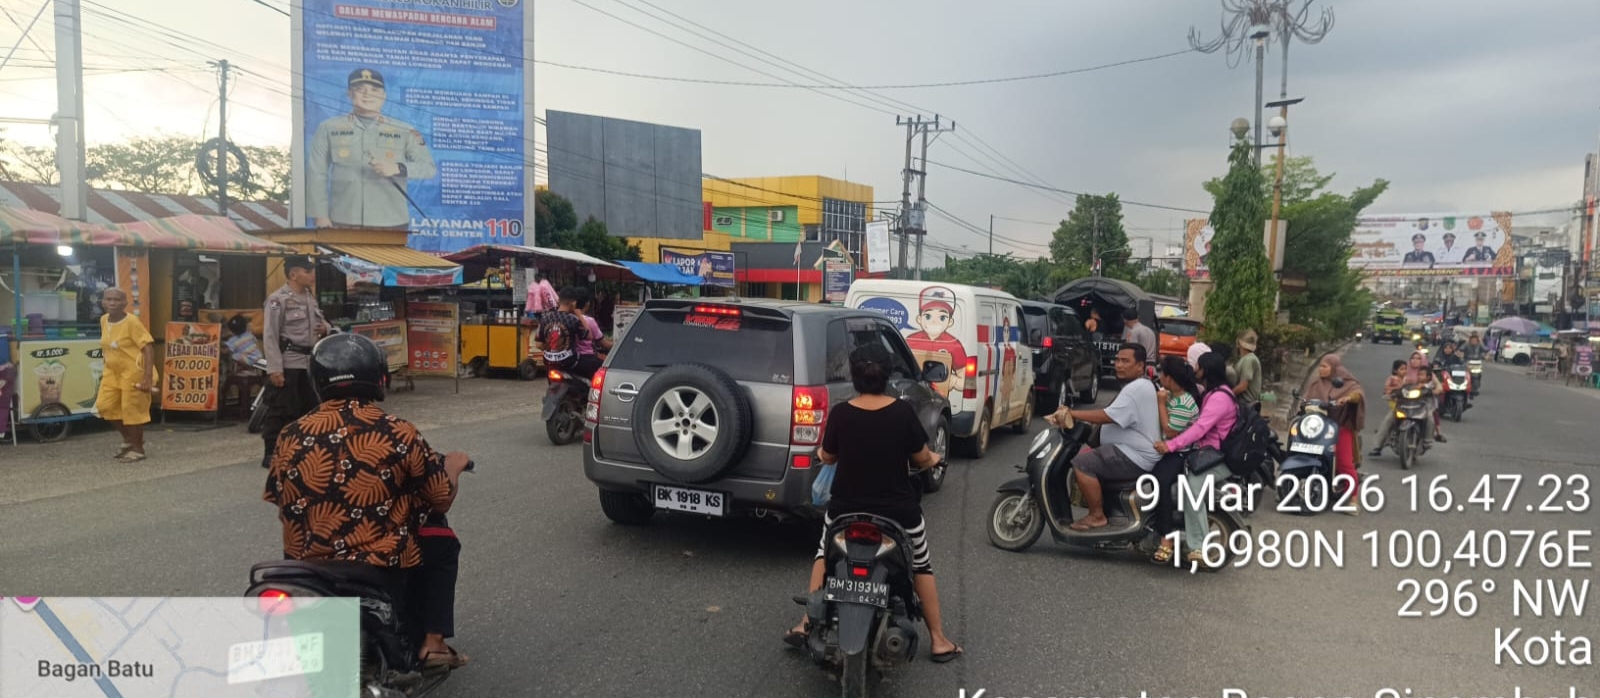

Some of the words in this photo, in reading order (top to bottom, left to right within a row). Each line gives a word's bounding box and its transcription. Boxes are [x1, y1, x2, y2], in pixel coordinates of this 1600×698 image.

[339, 7, 368, 17] DALAM
[371, 10, 428, 22] MEWASPADAI
[430, 14, 467, 24] BENCANA
[470, 17, 493, 26] ALAM
[411, 218, 483, 230] LAYANAN
[485, 218, 522, 238] 110
[672, 257, 695, 266] LAPOR
[890, 308, 905, 316] Care
[167, 343, 191, 357] KEBAB
[192, 343, 217, 358] DAGING
[174, 360, 210, 370] 10.000
[168, 374, 185, 390] ES
[190, 375, 213, 390] TEH
[175, 393, 207, 404] 5.000
[658, 488, 672, 501] BK
[676, 491, 700, 504] 1918
[705, 494, 720, 507] KS
[829, 578, 845, 590] BM
[846, 580, 872, 593] 3193
[873, 584, 887, 596] WM
